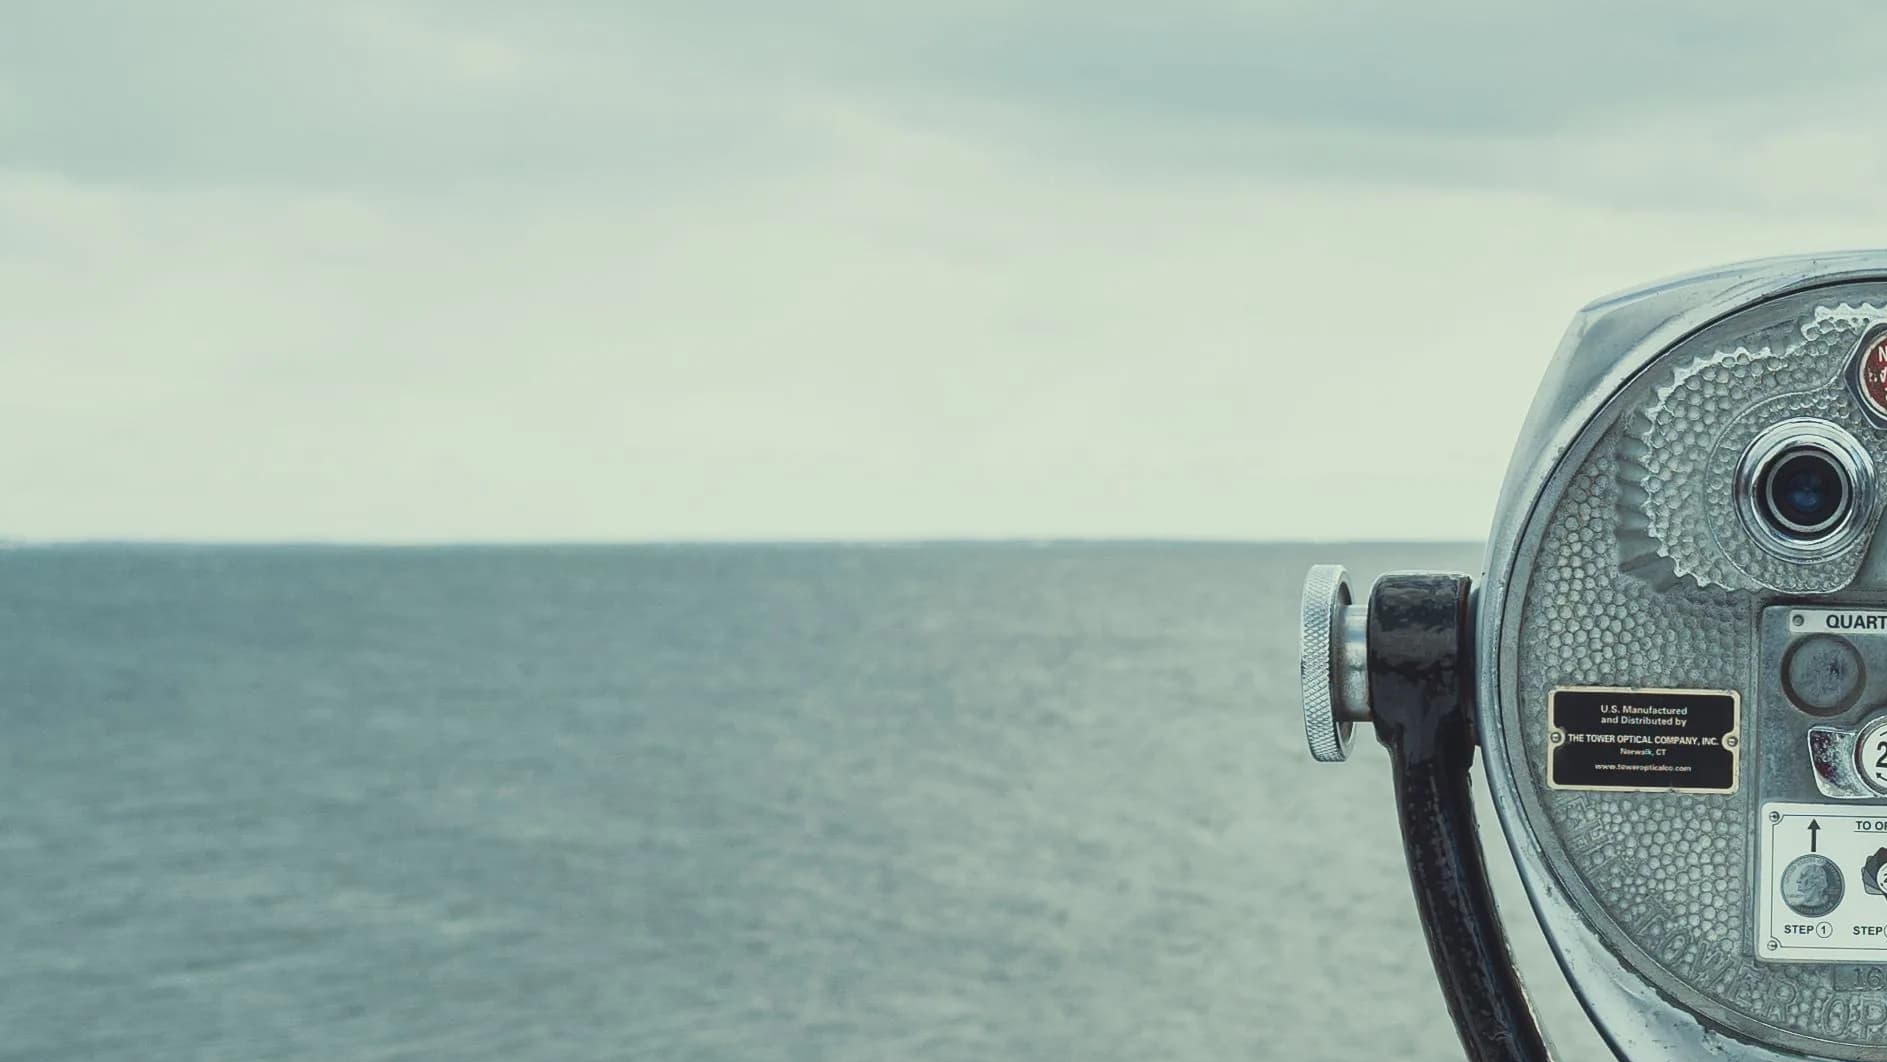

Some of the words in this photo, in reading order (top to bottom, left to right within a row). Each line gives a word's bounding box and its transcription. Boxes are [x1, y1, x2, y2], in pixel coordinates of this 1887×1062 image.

[1600, 704, 1620, 714] U.S.
[1622, 705, 1688, 715] Manufactured
[1601, 716, 1619, 724] and
[1621, 716, 1673, 726] Distributed
[1675, 717, 1687, 728] by
[1568, 733, 1584, 743] THE
[1586, 734, 1615, 743] TOWER
[1617, 734, 1652, 744] OPTICAL
[1654, 735, 1700, 746] COMPANY,
[1702, 737, 1719, 746] INC.
[1656, 748, 1667, 756] CT
[1594, 763, 1692, 773] www.toweropticalcocom
[1856, 821, 1873, 831] TO
[1784, 924, 1814, 934] STEP
[1853, 926, 1883, 936] STEP
[1627, 893, 1801, 1025] TOWER
